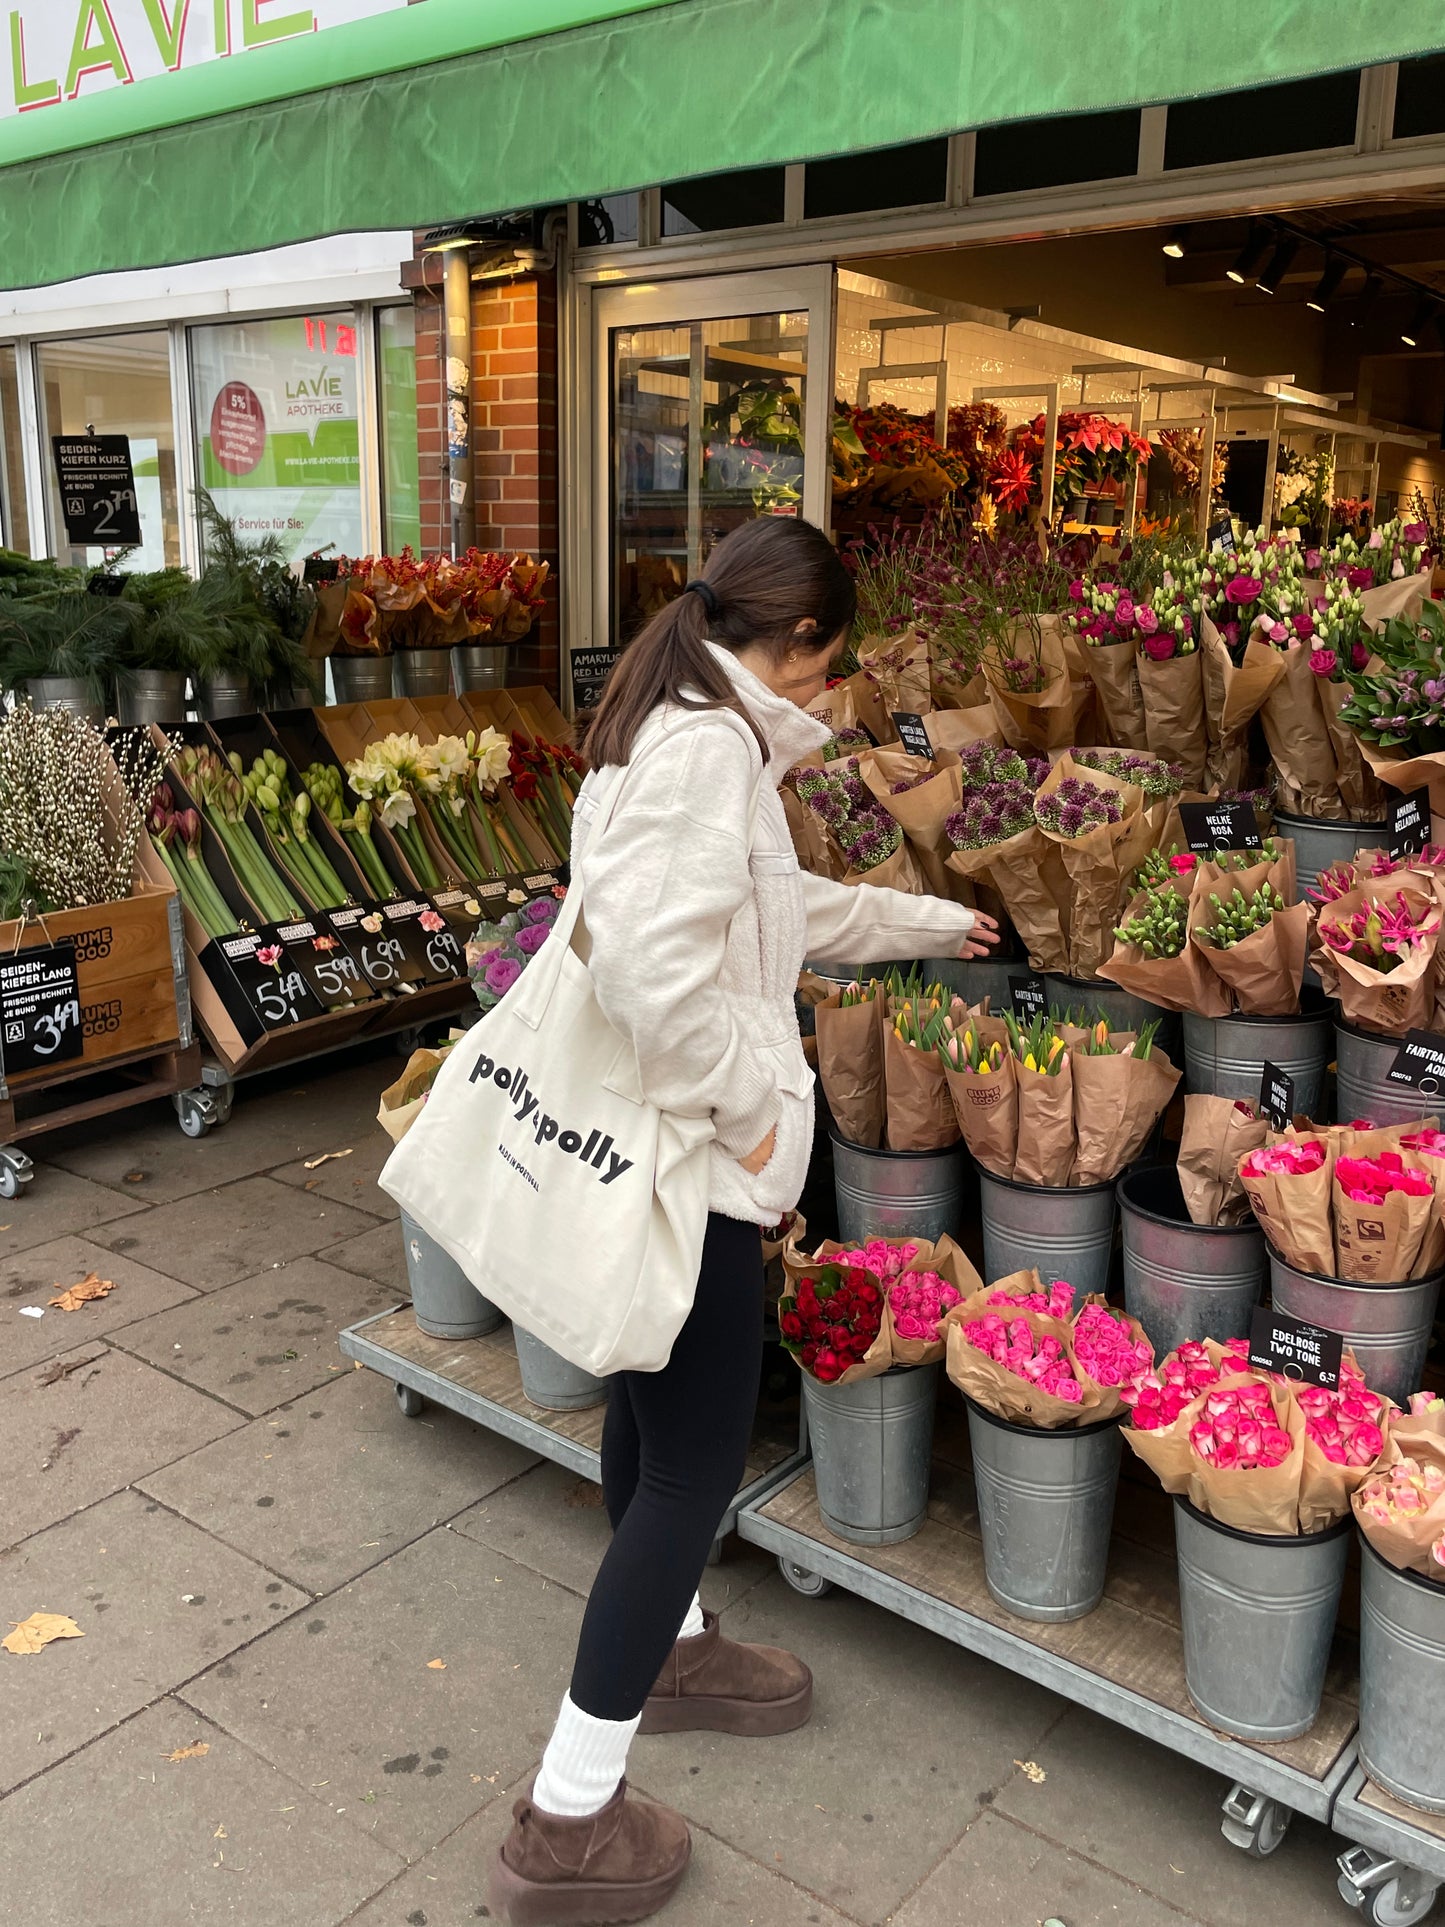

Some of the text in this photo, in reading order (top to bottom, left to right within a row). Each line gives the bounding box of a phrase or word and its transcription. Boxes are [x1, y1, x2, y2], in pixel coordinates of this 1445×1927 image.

[231, 394, 246, 409] 5%
[286, 403, 344, 416] APOTHEKE
[59, 445, 102, 454] SEIDEN-
[61, 455, 127, 465] KIEFER KURZ
[99, 473, 128, 481] SCHNITT
[238, 518, 270, 530] Service
[273, 517, 285, 529] für
[287, 517, 305, 529] Sie:
[573, 669, 592, 678] RED
[1205, 815, 1233, 826] NELKE
[1210, 825, 1234, 836] ROSA
[223, 936, 261, 949] AMARYLLIS
[227, 945, 255, 956] DAPHNE
[0, 961, 46, 978] SEIDEN-
[1, 967, 72, 990] KIEFER LANG
[3, 987, 73, 1009] FRISCHER SCHNITT
[4, 1005, 37, 1018] JE BUND
[1425, 1062, 1445, 1078] AQU
[966, 1085, 1001, 1099] BLUME
[971, 1094, 1001, 1105] 2000
[498, 1143, 540, 1192] MADE IN PORTUGAL
[1272, 1328, 1321, 1355] EDELROSE
[1270, 1340, 1321, 1367] TWO TONE
